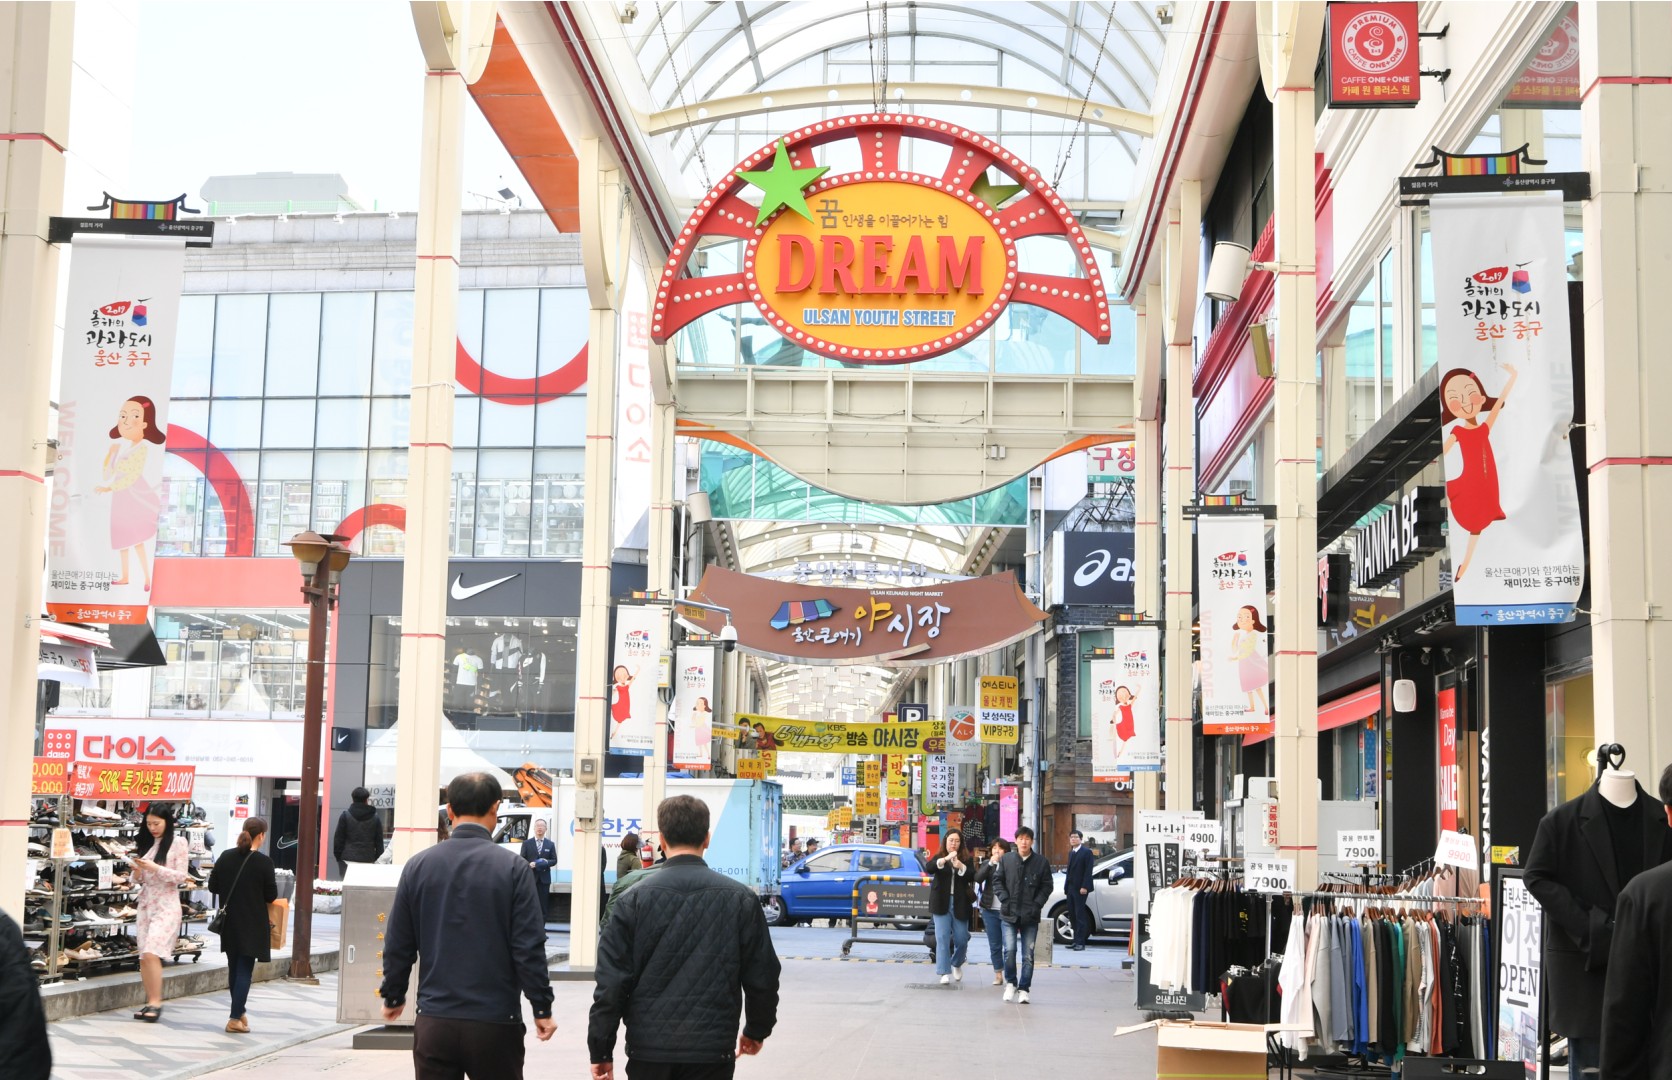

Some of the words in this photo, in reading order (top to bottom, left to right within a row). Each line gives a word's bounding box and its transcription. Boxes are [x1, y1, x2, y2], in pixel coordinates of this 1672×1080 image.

[1352, 11, 1398, 31] PREMIUM
[1347, 48, 1368, 69] CAFFE
[1369, 48, 1403, 69] ONE+ONE
[1341, 76, 1367, 84] CAFFE
[1367, 76, 1411, 84] ONE+ONE
[1342, 85, 1360, 96] 카페
[1362, 85, 1372, 96] 원
[1373, 85, 1399, 96] 플러스
[1401, 85, 1411, 96] 원
[816, 199, 843, 229] 꿈
[843, 213, 876, 229] 인생을
[878, 213, 934, 229] 이끌어가는
[937, 213, 949, 229] 힘
[775, 233, 985, 298] DREAM
[1480, 272, 1503, 282] 2019
[1464, 277, 1504, 297] 올해의
[105, 305, 126, 315] 2019
[803, 308, 850, 326] ULSAN
[853, 309, 900, 326] YOUTH
[902, 309, 956, 327] STREET
[1461, 298, 1540, 320] 관광도시
[90, 309, 125, 328] 올해의
[86, 329, 152, 348] 관광도시
[1474, 321, 1507, 341] 울산
[1512, 321, 1544, 340] 중구
[94, 349, 122, 367] 울산
[126, 350, 152, 367] 중구
[1355, 504, 1399, 588] WANNA
[1402, 486, 1419, 558] BE
[1212, 568, 1252, 580] 관광도시
[1484, 566, 1540, 578] 울산큰애기와
[1542, 564, 1581, 577] 함께하는
[50, 580, 77, 591] 재미있는
[79, 580, 110, 592] 중구여행
[1218, 580, 1234, 591] 울산
[1237, 580, 1253, 590] 중구
[1504, 577, 1542, 589] 재미있는
[1544, 576, 1581, 587] 중구여행
[76, 608, 116, 620] 울산광역시
[118, 609, 132, 620] 중구
[854, 596, 951, 647] 야시장
[1496, 609, 1545, 621] 울산광역시
[1548, 608, 1566, 620] 중구
[981, 681, 1017, 690] 에스티나
[906, 709, 921, 722] P
[982, 711, 1015, 722] 보성식당
[774, 724, 806, 741] 6시
[846, 731, 868, 747] 방송
[874, 728, 919, 748] 야시장
[1443, 723, 1456, 752] Day
[83, 735, 176, 760] 다이소
[790, 733, 842, 750] 내고향
[46, 749, 70, 758] daiso
[99, 769, 122, 794] 50%
[121, 768, 163, 796] 특가상품
[164, 771, 193, 796] 20,000
[1268, 804, 1278, 845] 전동제어기
[1190, 833, 1215, 844] 4900
[1344, 847, 1375, 857] 7900
[1447, 849, 1471, 862] 9900
[1252, 877, 1288, 890] 7900
[1504, 911, 1541, 968] 이전
[1500, 962, 1539, 998] OPEN
[1155, 994, 1187, 1005] 인생사진
